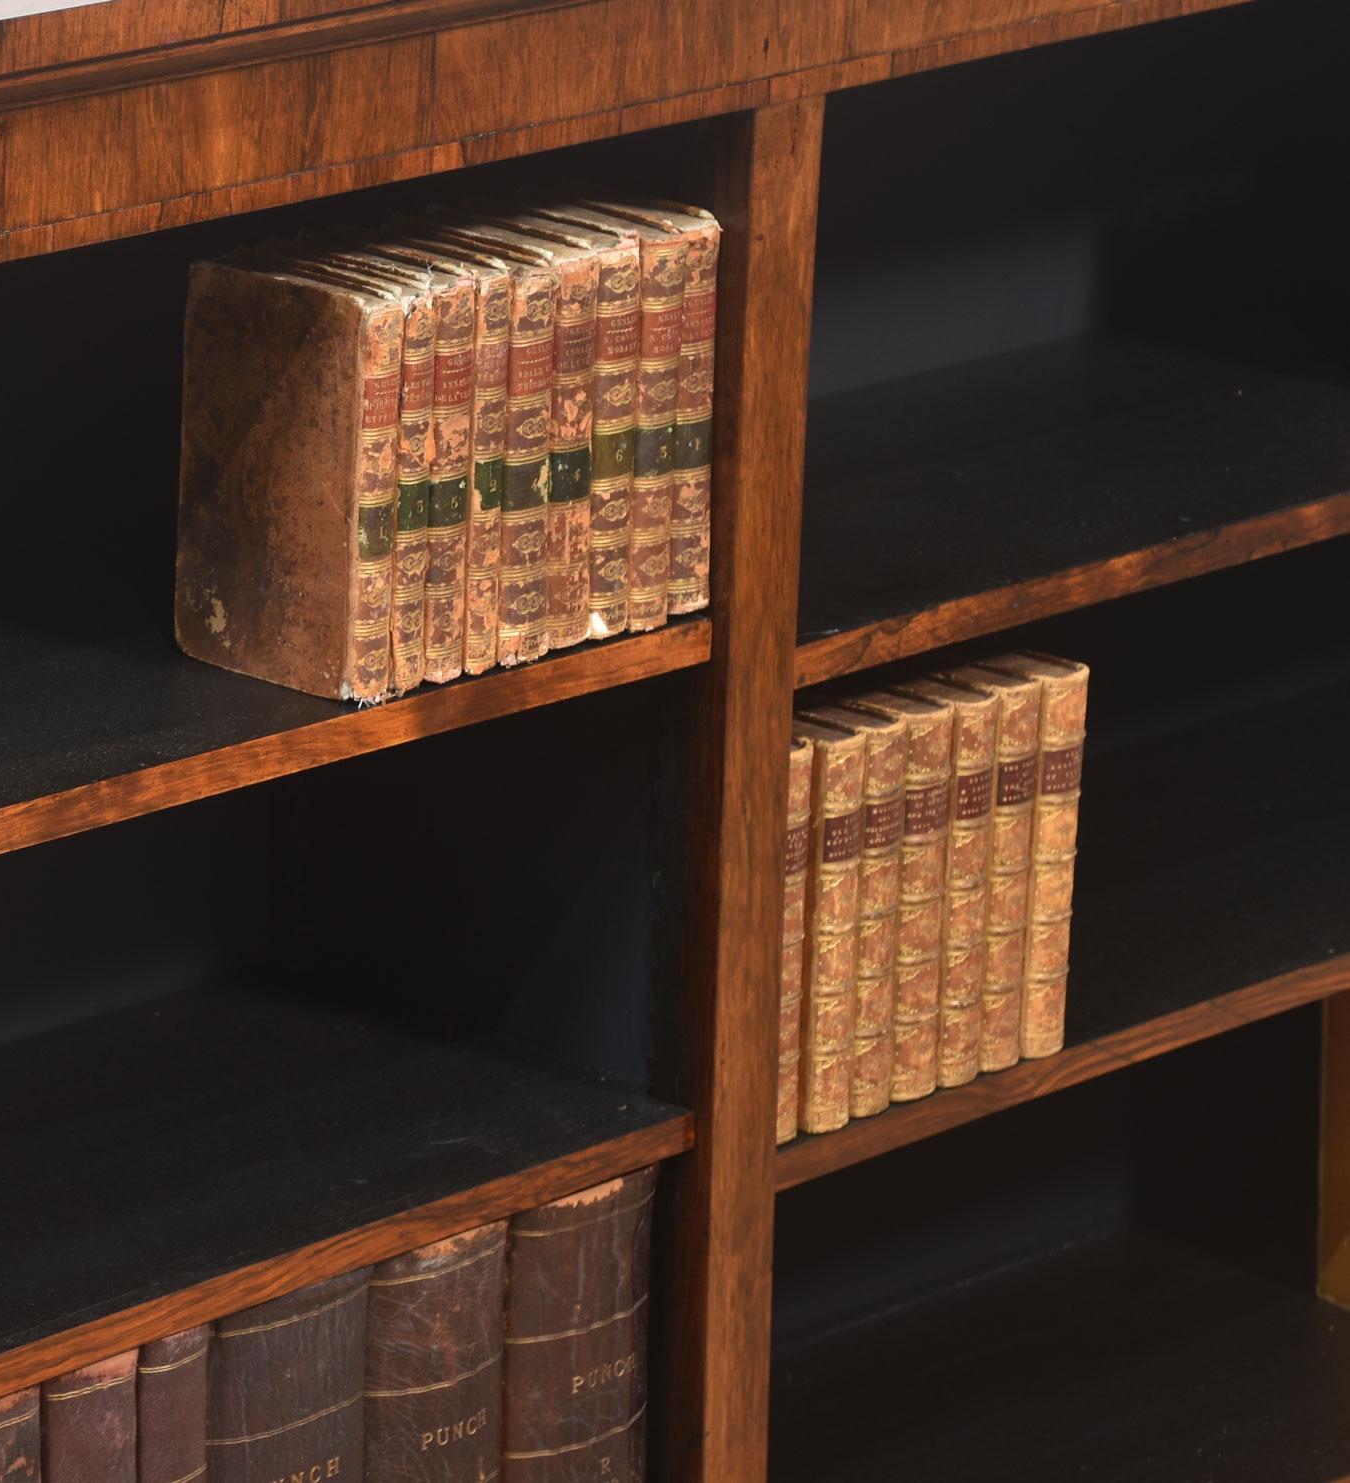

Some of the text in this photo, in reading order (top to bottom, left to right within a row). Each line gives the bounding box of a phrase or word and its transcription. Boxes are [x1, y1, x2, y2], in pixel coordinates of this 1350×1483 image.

[615, 448, 624, 463] 6
[570, 1351, 636, 1395] PUNCH
[419, 1405, 488, 1452] PUNCH
[600, 1456, 612, 1476] R
